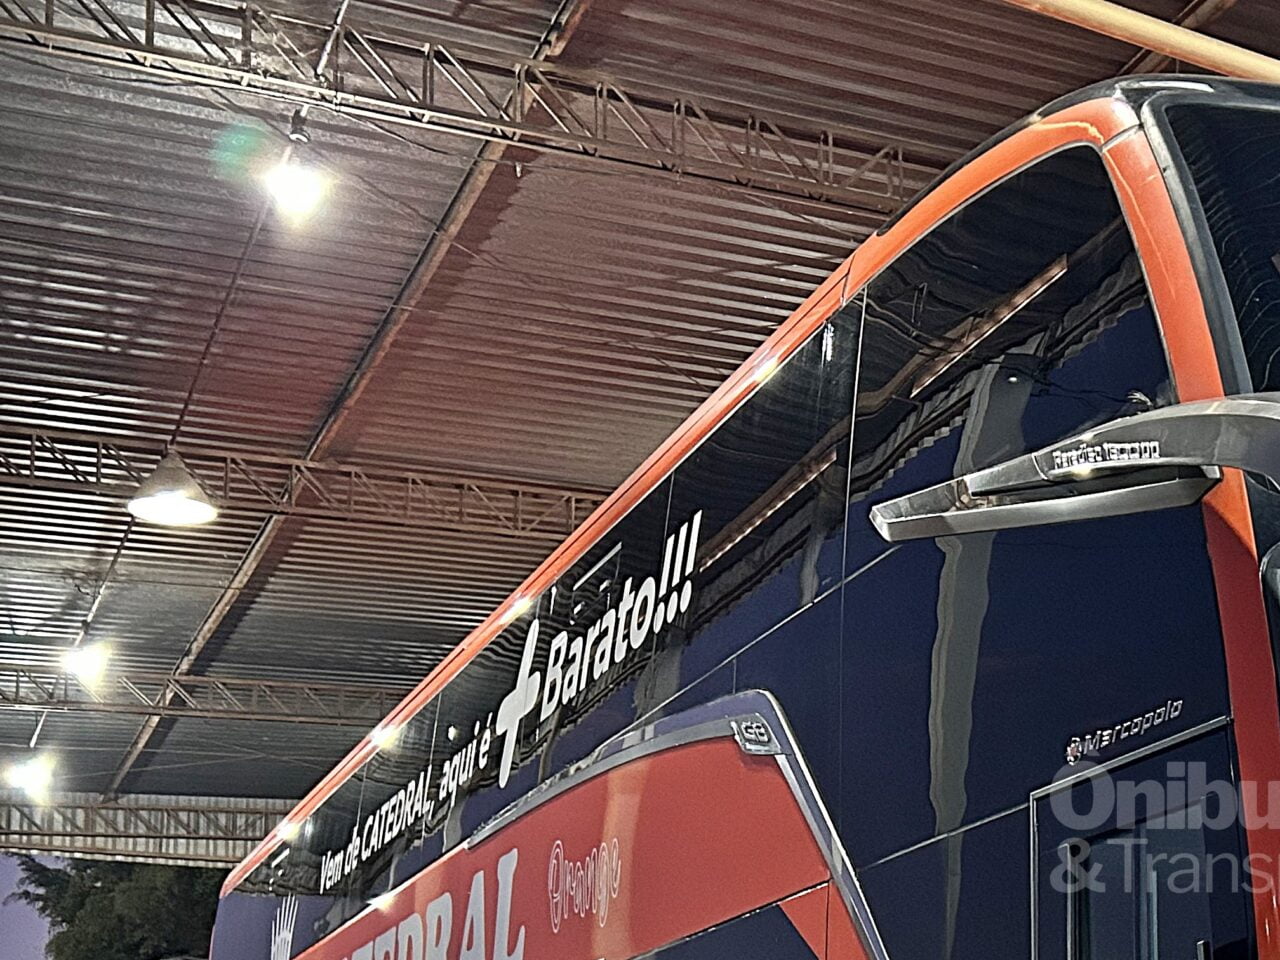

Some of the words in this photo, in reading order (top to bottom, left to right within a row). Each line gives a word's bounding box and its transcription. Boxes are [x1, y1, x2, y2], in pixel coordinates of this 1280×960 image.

[1083, 700, 1183, 755] Marcopolo
[319, 851, 344, 895] Vem
[344, 825, 361, 876] de
[439, 720, 480, 809] aqui
[478, 712, 493, 769] é
